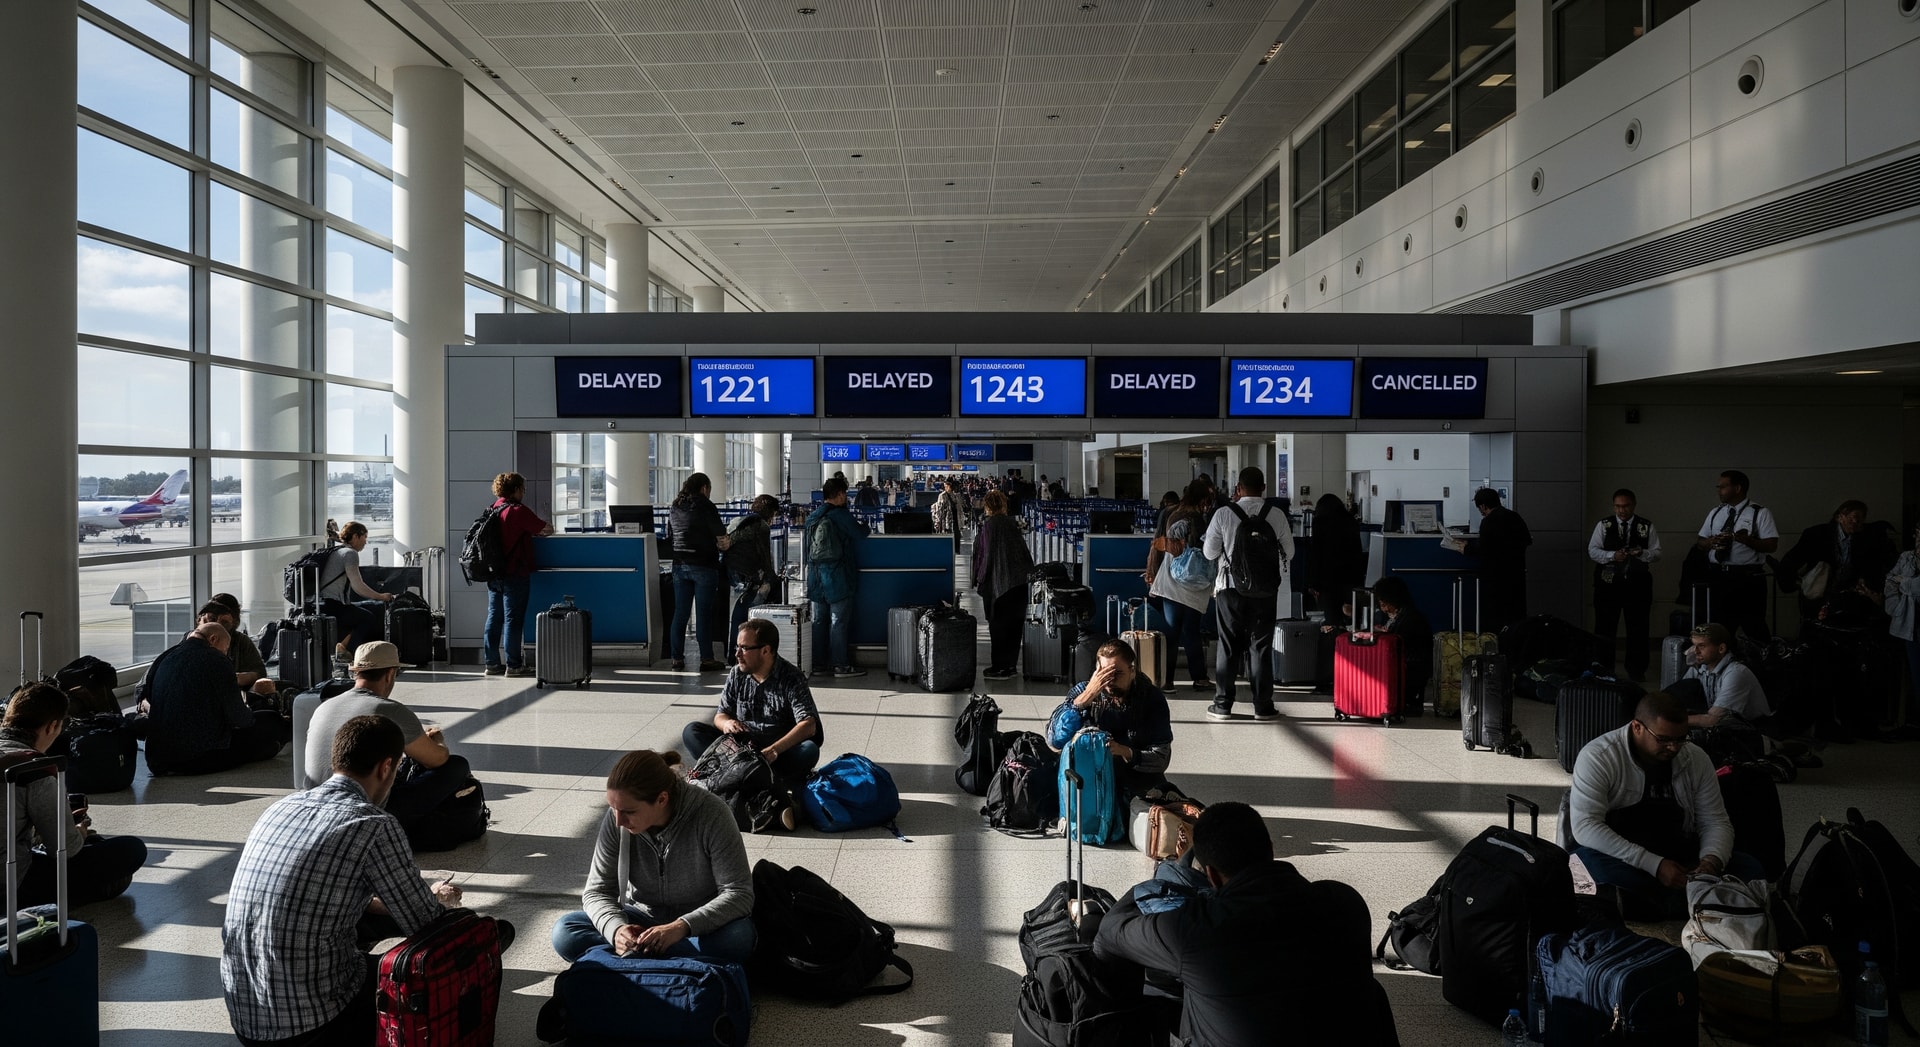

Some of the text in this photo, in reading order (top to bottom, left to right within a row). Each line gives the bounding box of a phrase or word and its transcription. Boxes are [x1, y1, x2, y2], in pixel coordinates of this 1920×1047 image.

[578, 372, 662, 389] DELAYED
[700, 375, 770, 403] 1221
[848, 372, 933, 389] DELAYED
[970, 375, 1046, 403] 1243
[1110, 373, 1196, 390] DELAYED
[1371, 374, 1477, 391] CANCELLED
[1238, 376, 1314, 404] 1234
